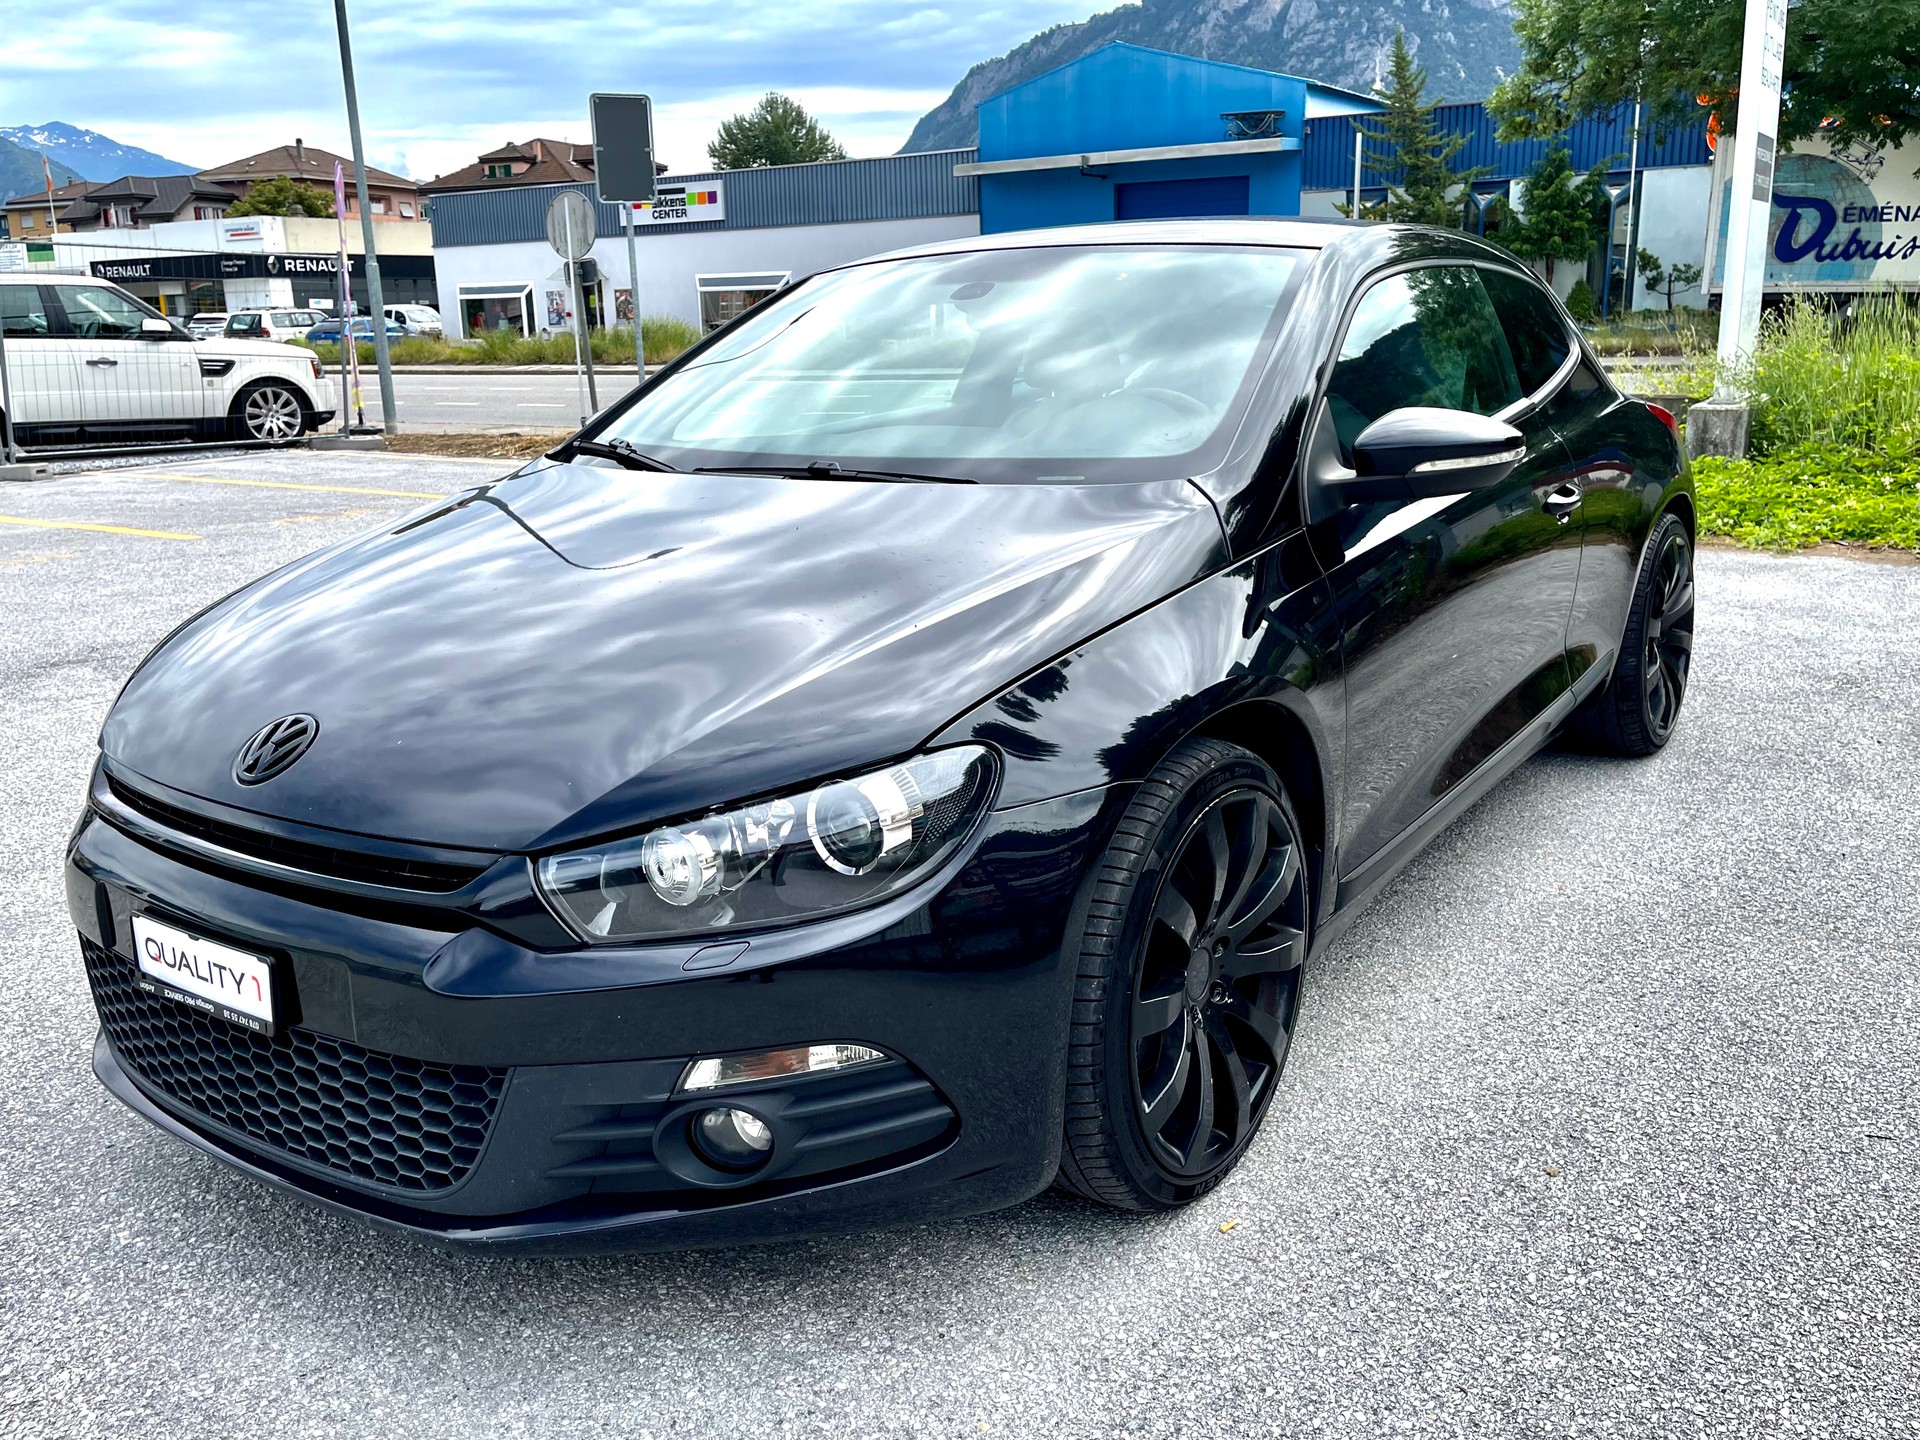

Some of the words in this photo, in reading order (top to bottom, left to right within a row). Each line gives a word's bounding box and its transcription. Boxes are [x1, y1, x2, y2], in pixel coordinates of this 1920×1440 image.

[652, 208, 687, 219] CENTER
[1772, 192, 1920, 263] Dubuis
[105, 264, 151, 278] RENAULT
[145, 937, 245, 995] QUALITY
[251, 975, 262, 1002] 1
[163, 988, 185, 1002] SERVICE
[184, 995, 196, 1006] PRO
